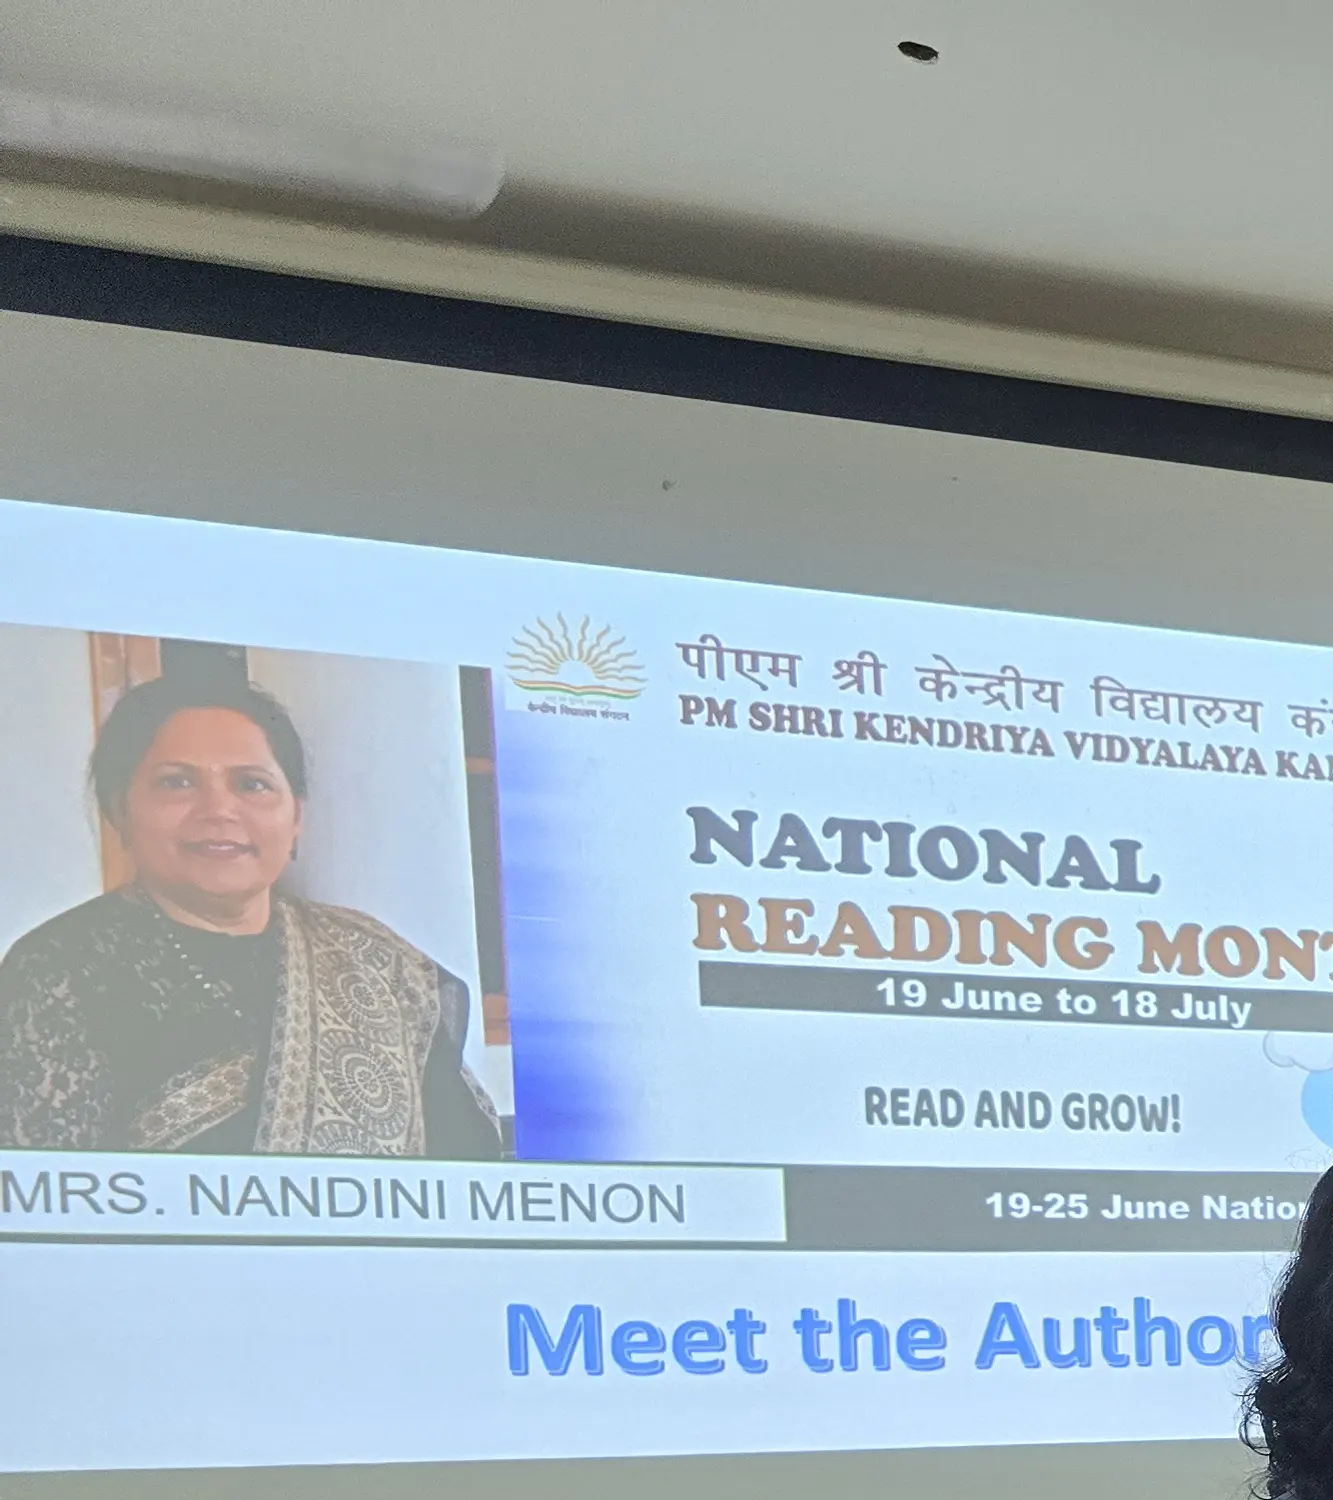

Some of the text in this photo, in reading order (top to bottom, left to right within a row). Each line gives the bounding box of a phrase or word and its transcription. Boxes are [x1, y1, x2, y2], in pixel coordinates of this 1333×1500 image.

[675, 634, 802, 690] पीएम
[832, 650, 888, 697] श्री
[914, 654, 1064, 712] केन्द्रीय
[1090, 676, 1263, 732] विद्यालय
[678, 694, 737, 730] PM
[748, 698, 843, 739] SHRI
[854, 711, 1054, 758] KENDRIYA
[1064, 730, 1267, 776] VIDYALAYA
[686, 807, 1162, 895] NATIONAL
[690, 892, 1115, 971] READING
[876, 977, 1252, 1030] 19 June to 18 July
[865, 1085, 1182, 1134] READ AND GROW!
[0, 1169, 686, 1224] MRS. NANDINI MENON
[985, 1192, 1196, 1221] 19-25 June
[506, 1297, 1270, 1377] Meet the Author
